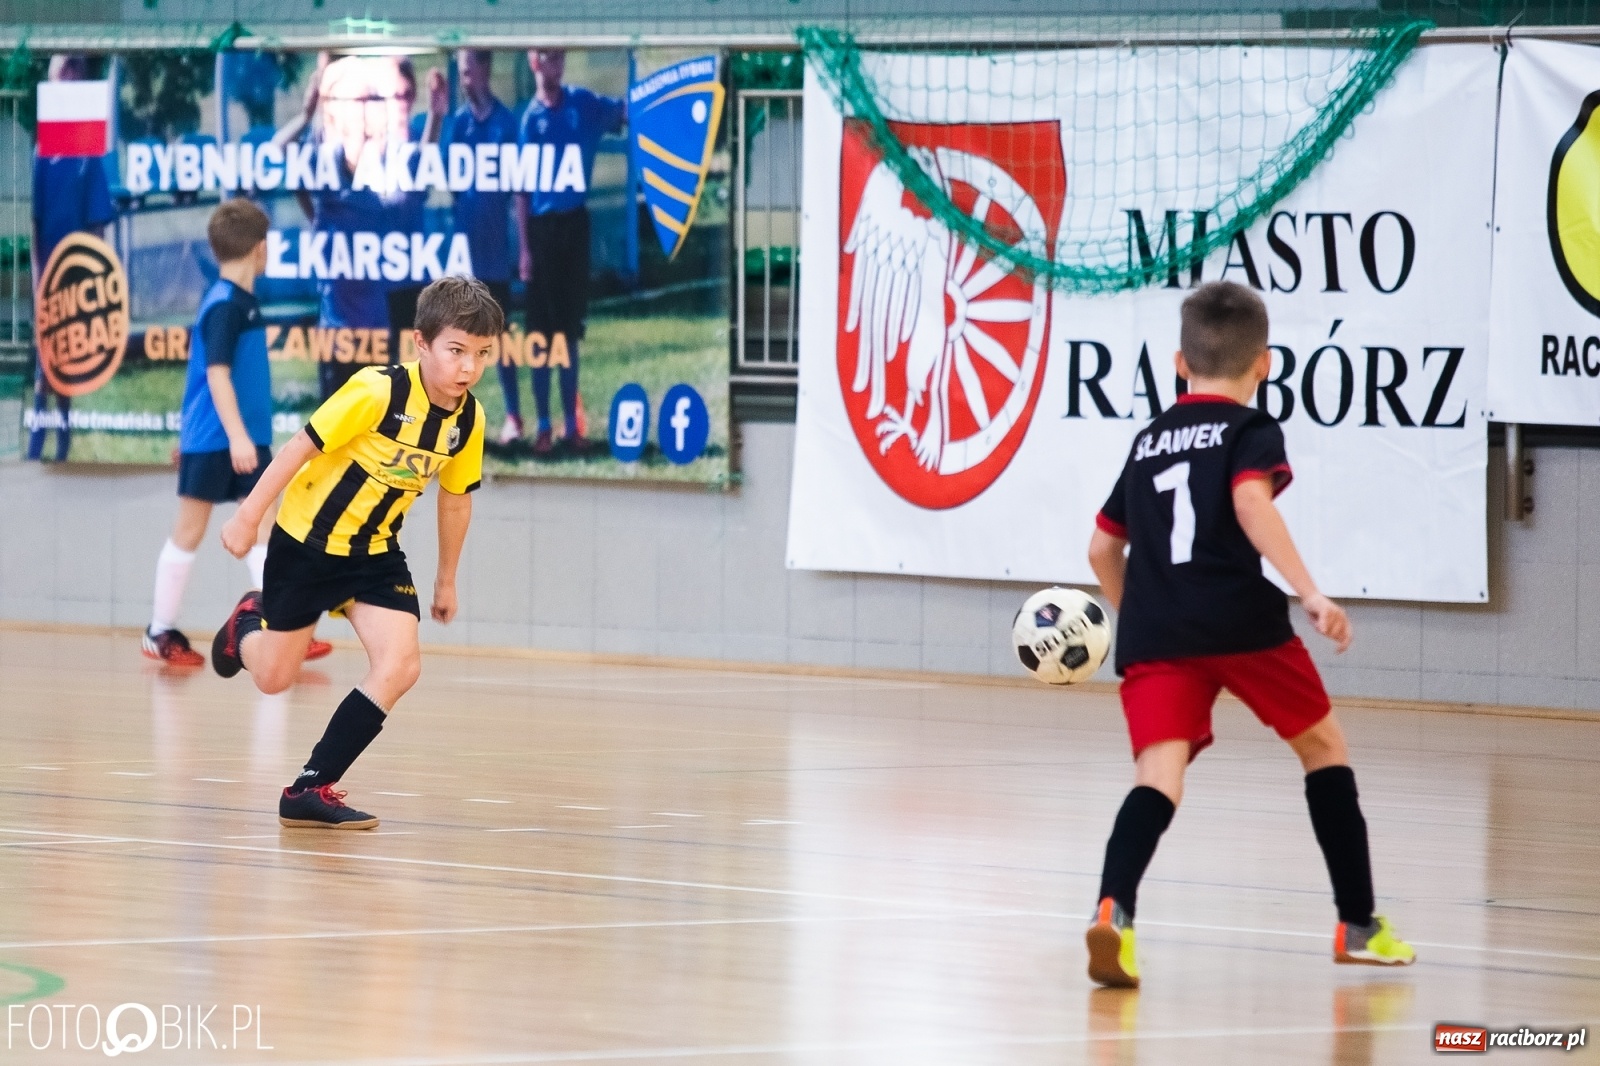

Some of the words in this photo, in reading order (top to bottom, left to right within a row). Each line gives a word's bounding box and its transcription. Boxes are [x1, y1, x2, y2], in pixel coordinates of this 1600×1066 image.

[126, 142, 341, 192] RYBNICKA
[352, 142, 586, 193] AKADEMIA
[265, 230, 472, 282] ŁKARSKA
[1119, 208, 1416, 294] MIASTO
[1062, 320, 1468, 429] RABÓRZ
[1134, 422, 1229, 461] SŁAWEK
[1152, 460, 1196, 565] 1
